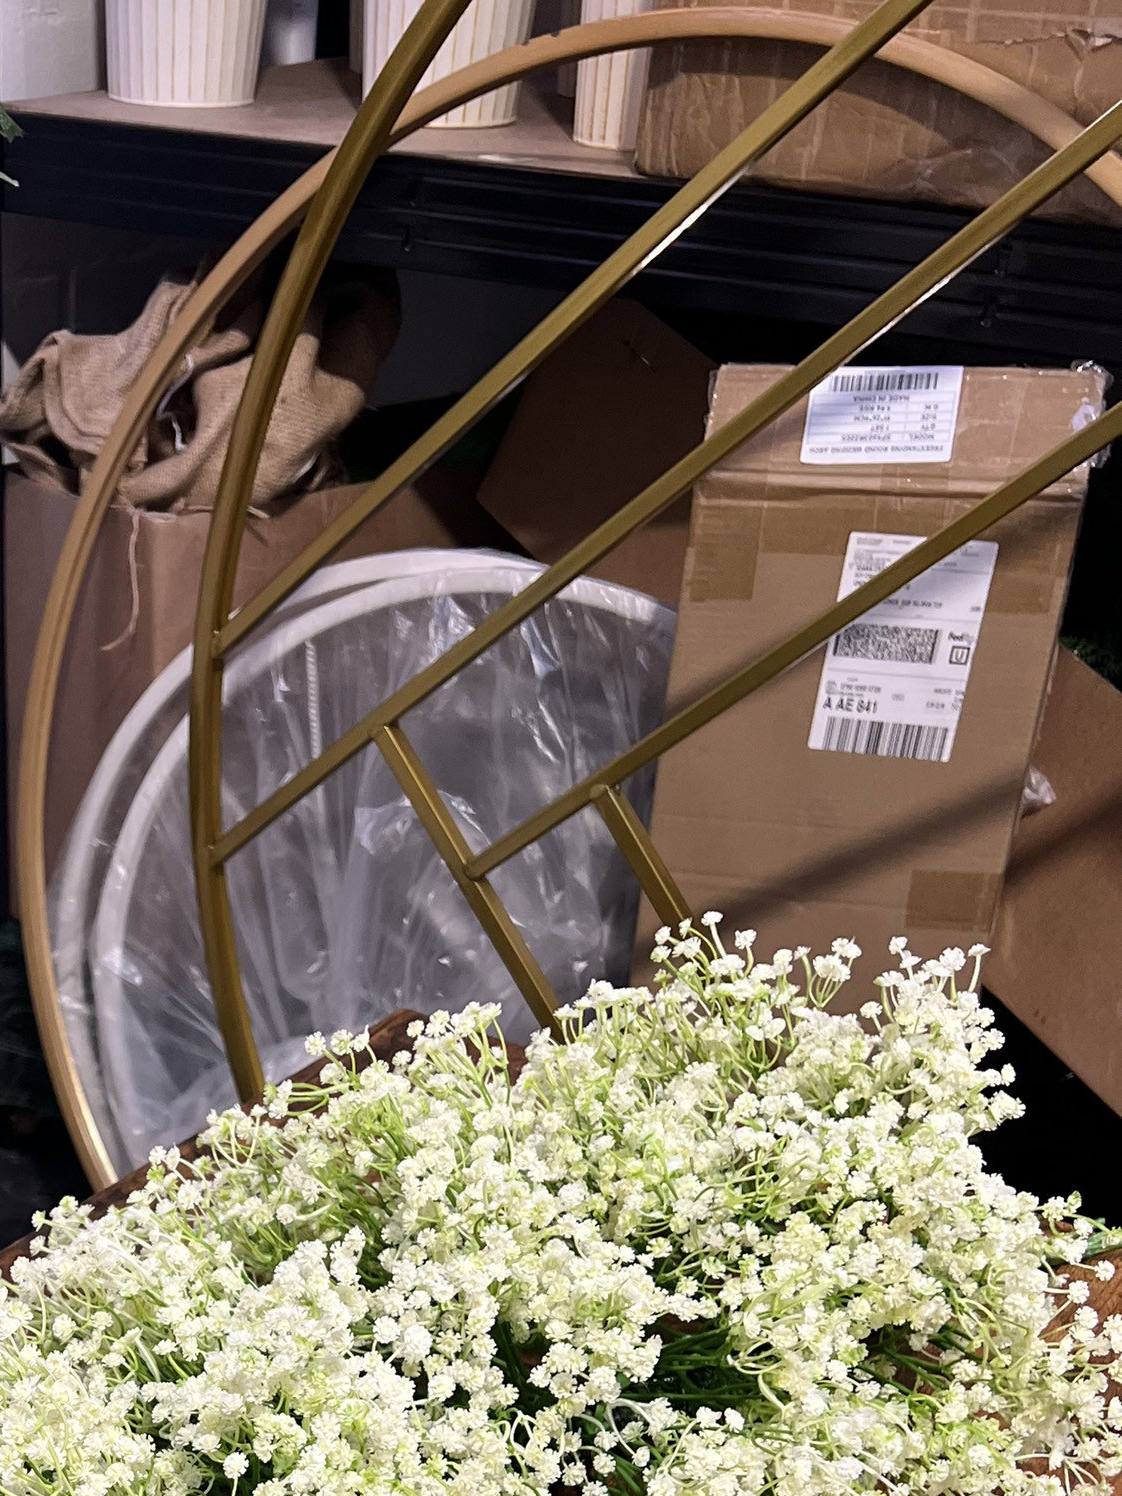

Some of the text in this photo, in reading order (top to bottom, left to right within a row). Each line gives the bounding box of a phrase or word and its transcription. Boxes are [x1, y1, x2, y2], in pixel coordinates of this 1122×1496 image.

[823, 697, 878, 714] A AE 841
